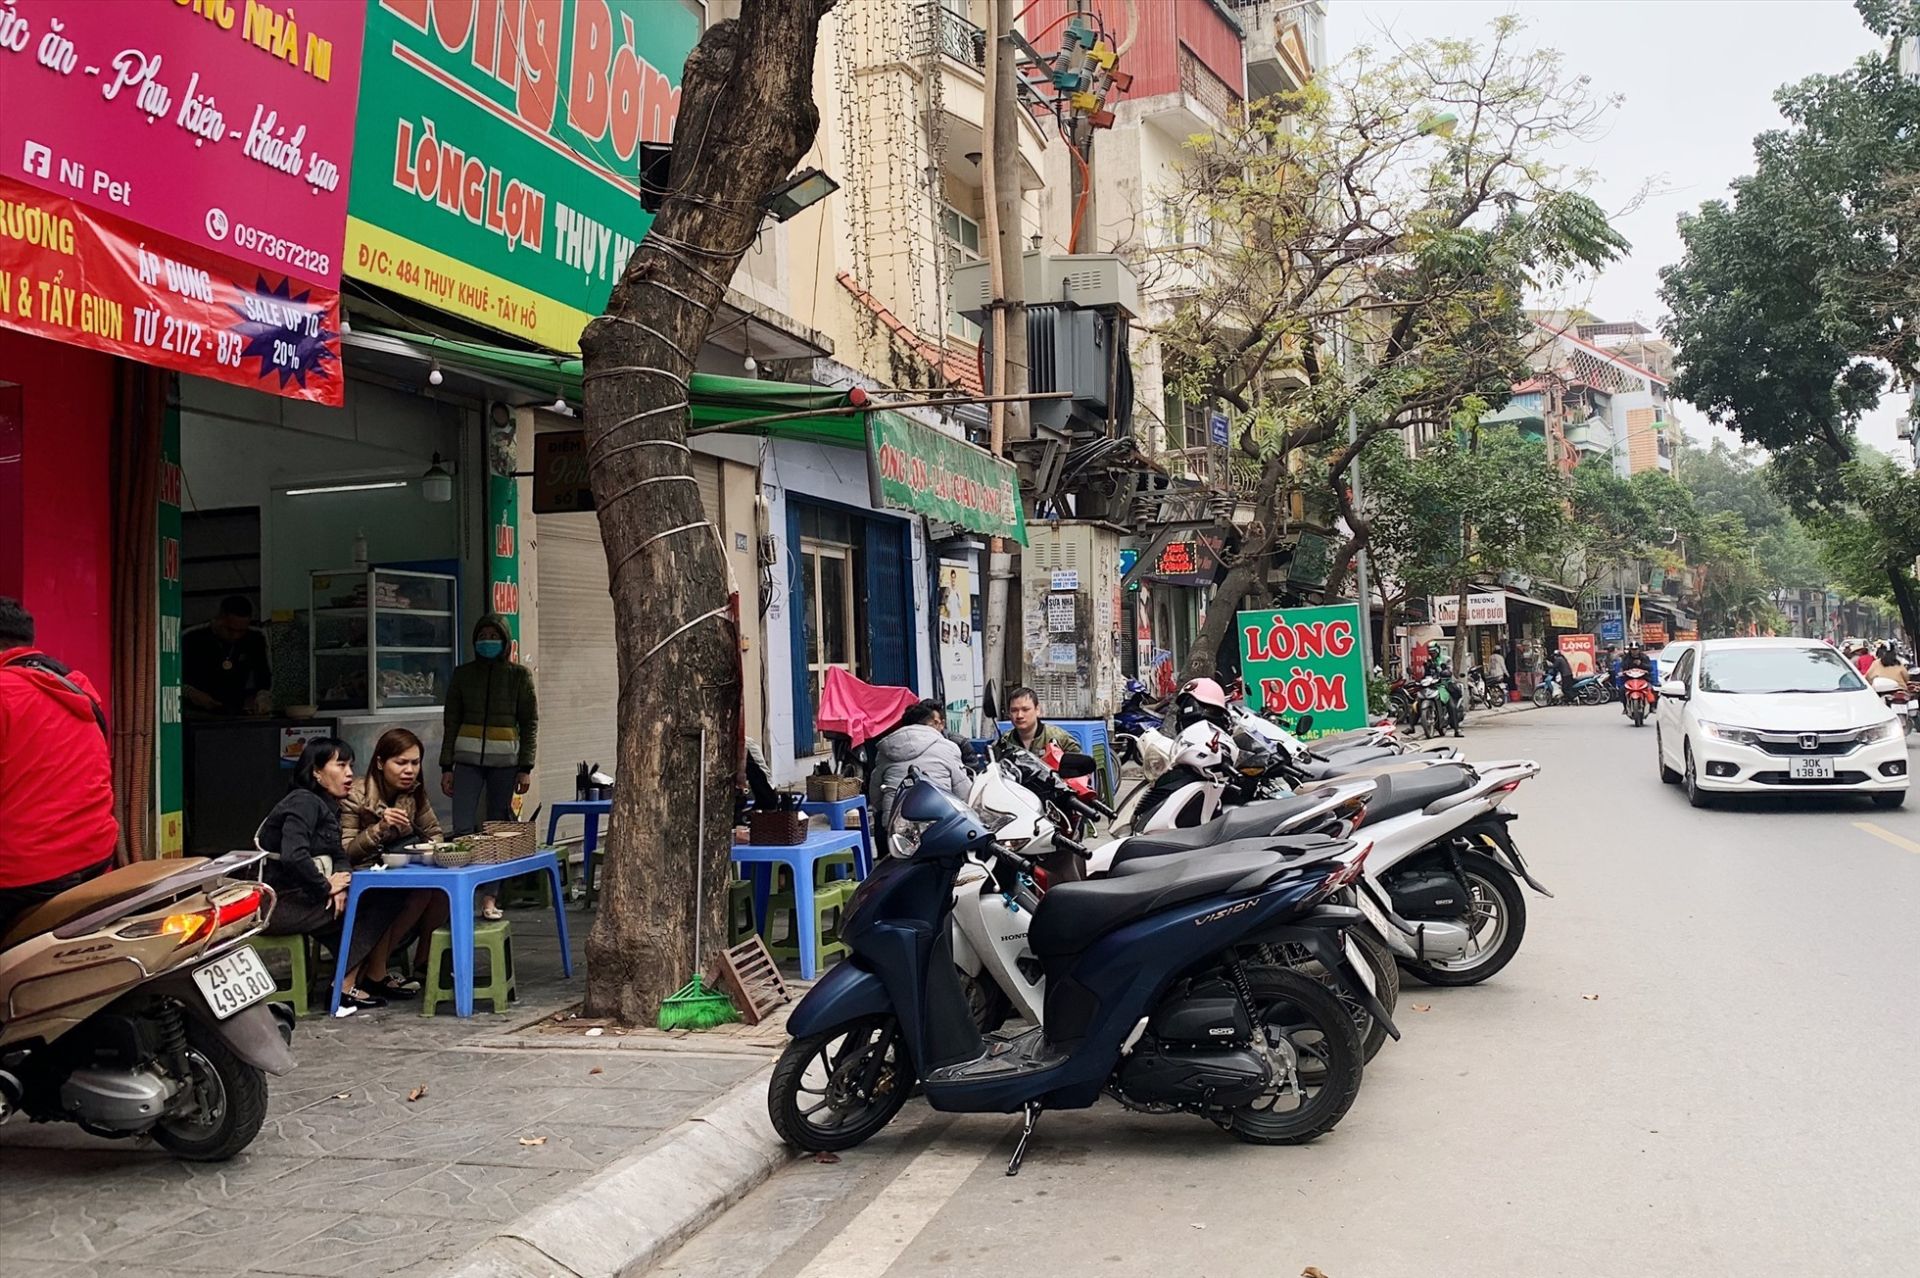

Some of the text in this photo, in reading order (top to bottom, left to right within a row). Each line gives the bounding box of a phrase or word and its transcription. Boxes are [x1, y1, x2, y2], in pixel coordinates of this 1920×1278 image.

[242, 0, 299, 66] NHÀ
[304, 31, 333, 82] NI
[37, 17, 78, 75] ăn
[102, 48, 172, 125] Phụ
[59, 157, 132, 207] Ni Pet
[392, 115, 487, 227] LÒNG
[484, 165, 546, 254] LỢN
[554, 201, 613, 287] THỤY
[137, 242, 214, 304] ÁP DỤNG
[233, 222, 330, 277] 0973672128
[38, 268, 76, 328] TẨY
[80, 292, 123, 342] GIUN
[358, 243, 393, 277] Đ/C:
[395, 259, 421, 288] 484
[423, 268, 456, 303] THỤY
[458, 283, 490, 313] KHUÊ
[497, 296, 518, 323] TÂY
[520, 300, 538, 331] HỒ
[133, 302, 161, 347] TỪ
[161, 315, 202, 359] 21/2
[216, 330, 244, 369] 8/3
[244, 295, 321, 339] SALE UP TO
[272, 339, 301, 371] 20%
[492, 575, 519, 616] CHÁO
[1244, 613, 1354, 663] LÒNG
[1260, 665, 1349, 714] BỜM
[1796, 768, 1829, 777] 138.91
[1802, 758, 1821, 768] 30K
[1194, 897, 1261, 927] VISION
[1000, 932, 1029, 942] HOND
[203, 951, 253, 990] 29-L5
[213, 971, 271, 1013] 499.80
